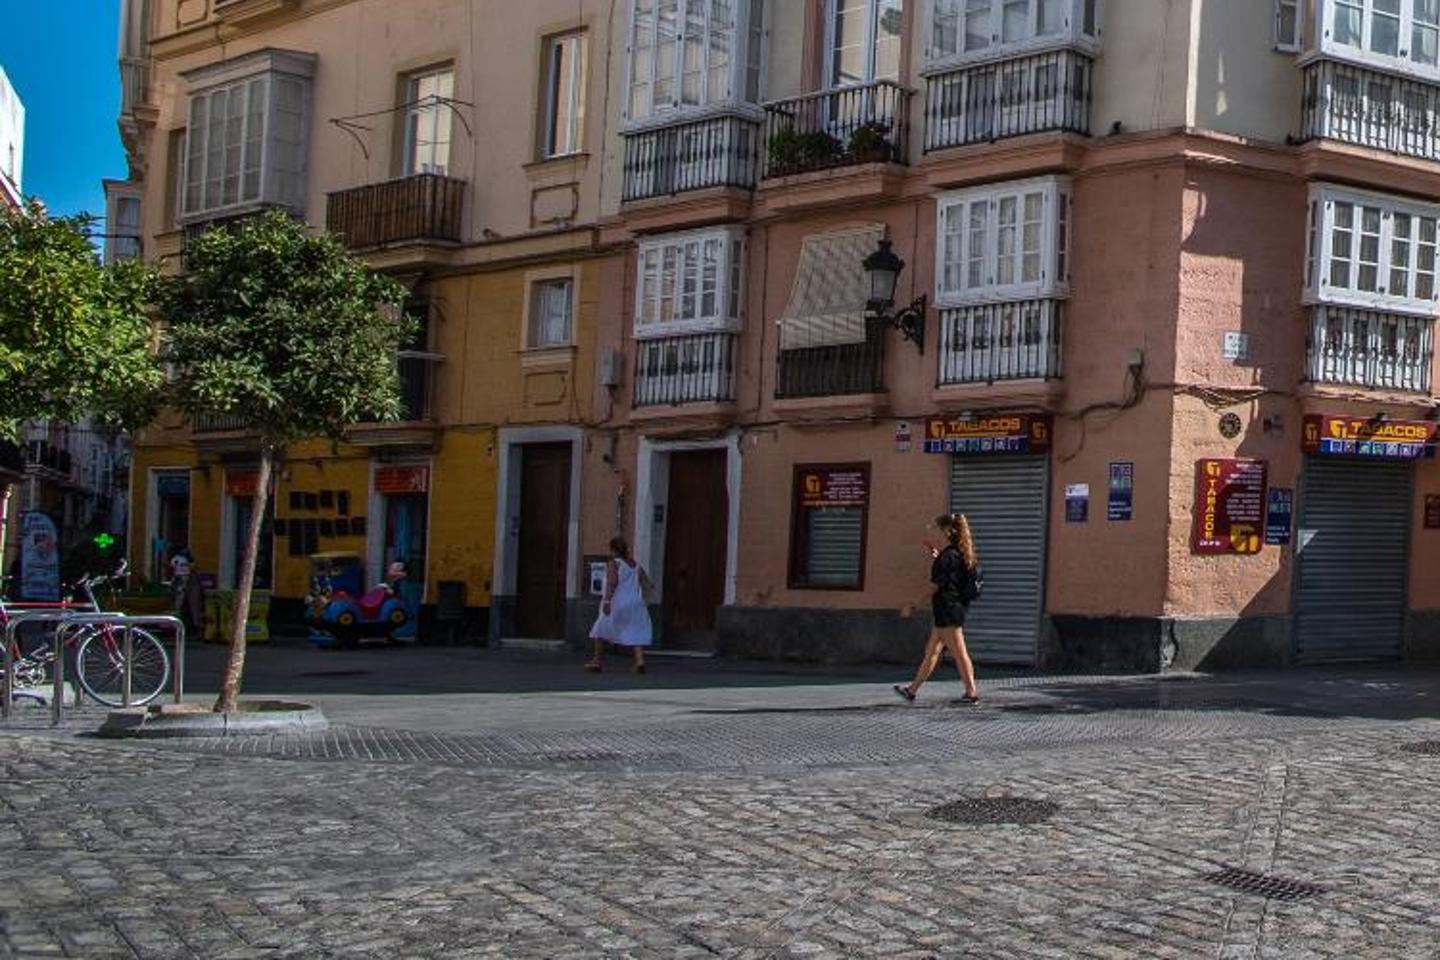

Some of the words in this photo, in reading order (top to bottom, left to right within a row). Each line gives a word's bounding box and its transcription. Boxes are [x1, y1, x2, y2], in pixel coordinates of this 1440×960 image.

[949, 417, 1020, 432] TABACOS
[1351, 421, 1428, 439] TABACOS
[1204, 480, 1217, 540] TABACOS
